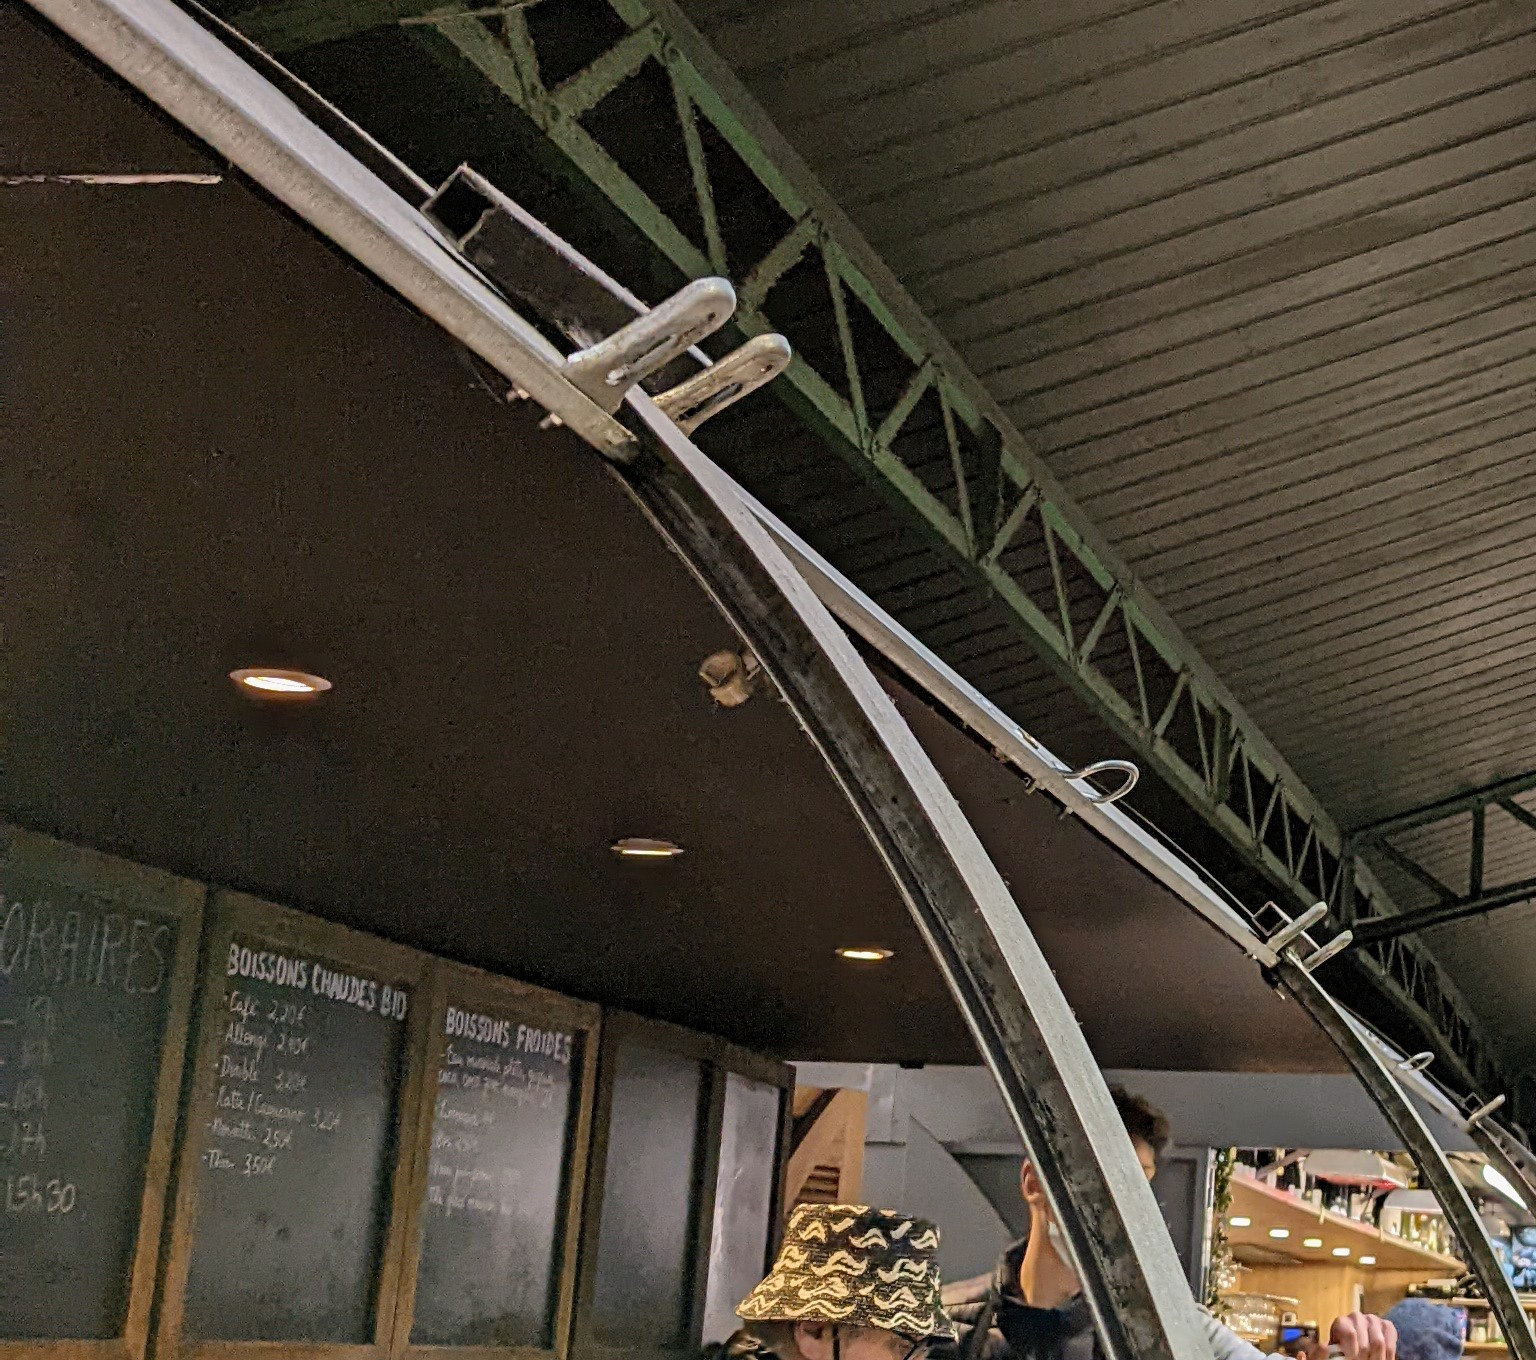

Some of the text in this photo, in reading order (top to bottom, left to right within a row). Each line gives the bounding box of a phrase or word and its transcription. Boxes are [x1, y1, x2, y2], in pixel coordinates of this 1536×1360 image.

[226, 942, 408, 1022] BOISSONS CHAUDES BIO
[445, 1006, 572, 1065] BOISSONS FROIDES
